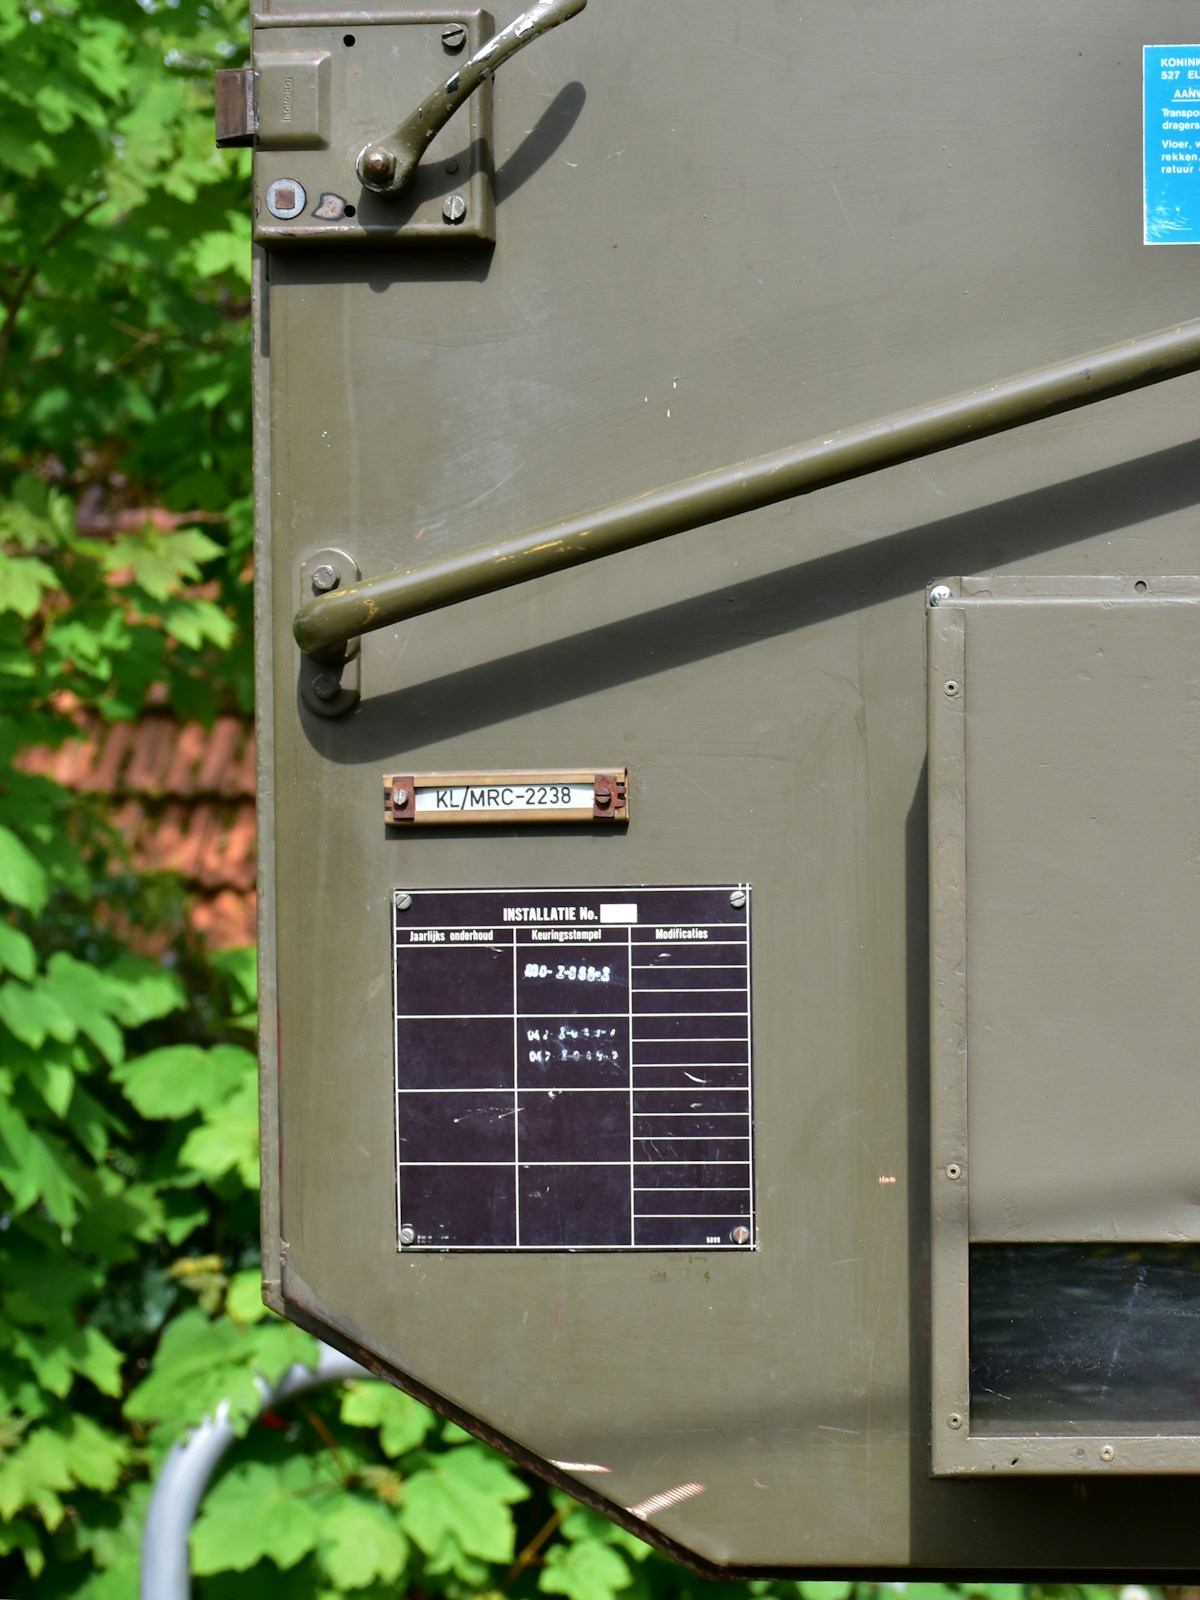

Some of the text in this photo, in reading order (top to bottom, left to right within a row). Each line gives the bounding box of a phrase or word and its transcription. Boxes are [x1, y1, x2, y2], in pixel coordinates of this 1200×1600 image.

[1161, 71, 1180, 80] 527
[1162, 121, 1200, 131] dragers
[1162, 140, 1192, 149] Vloer,
[1161, 152, 1200, 162] rekken,
[1161, 165, 1193, 174] ratuur
[436, 786, 571, 810] KL/MRC-2238
[503, 907, 598, 922] INSTALLATIE No.
[409, 930, 494, 943] Jaarlijks onderhoud
[532, 929, 602, 942] Keuringsstempel
[655, 928, 708, 940] Modificaties
